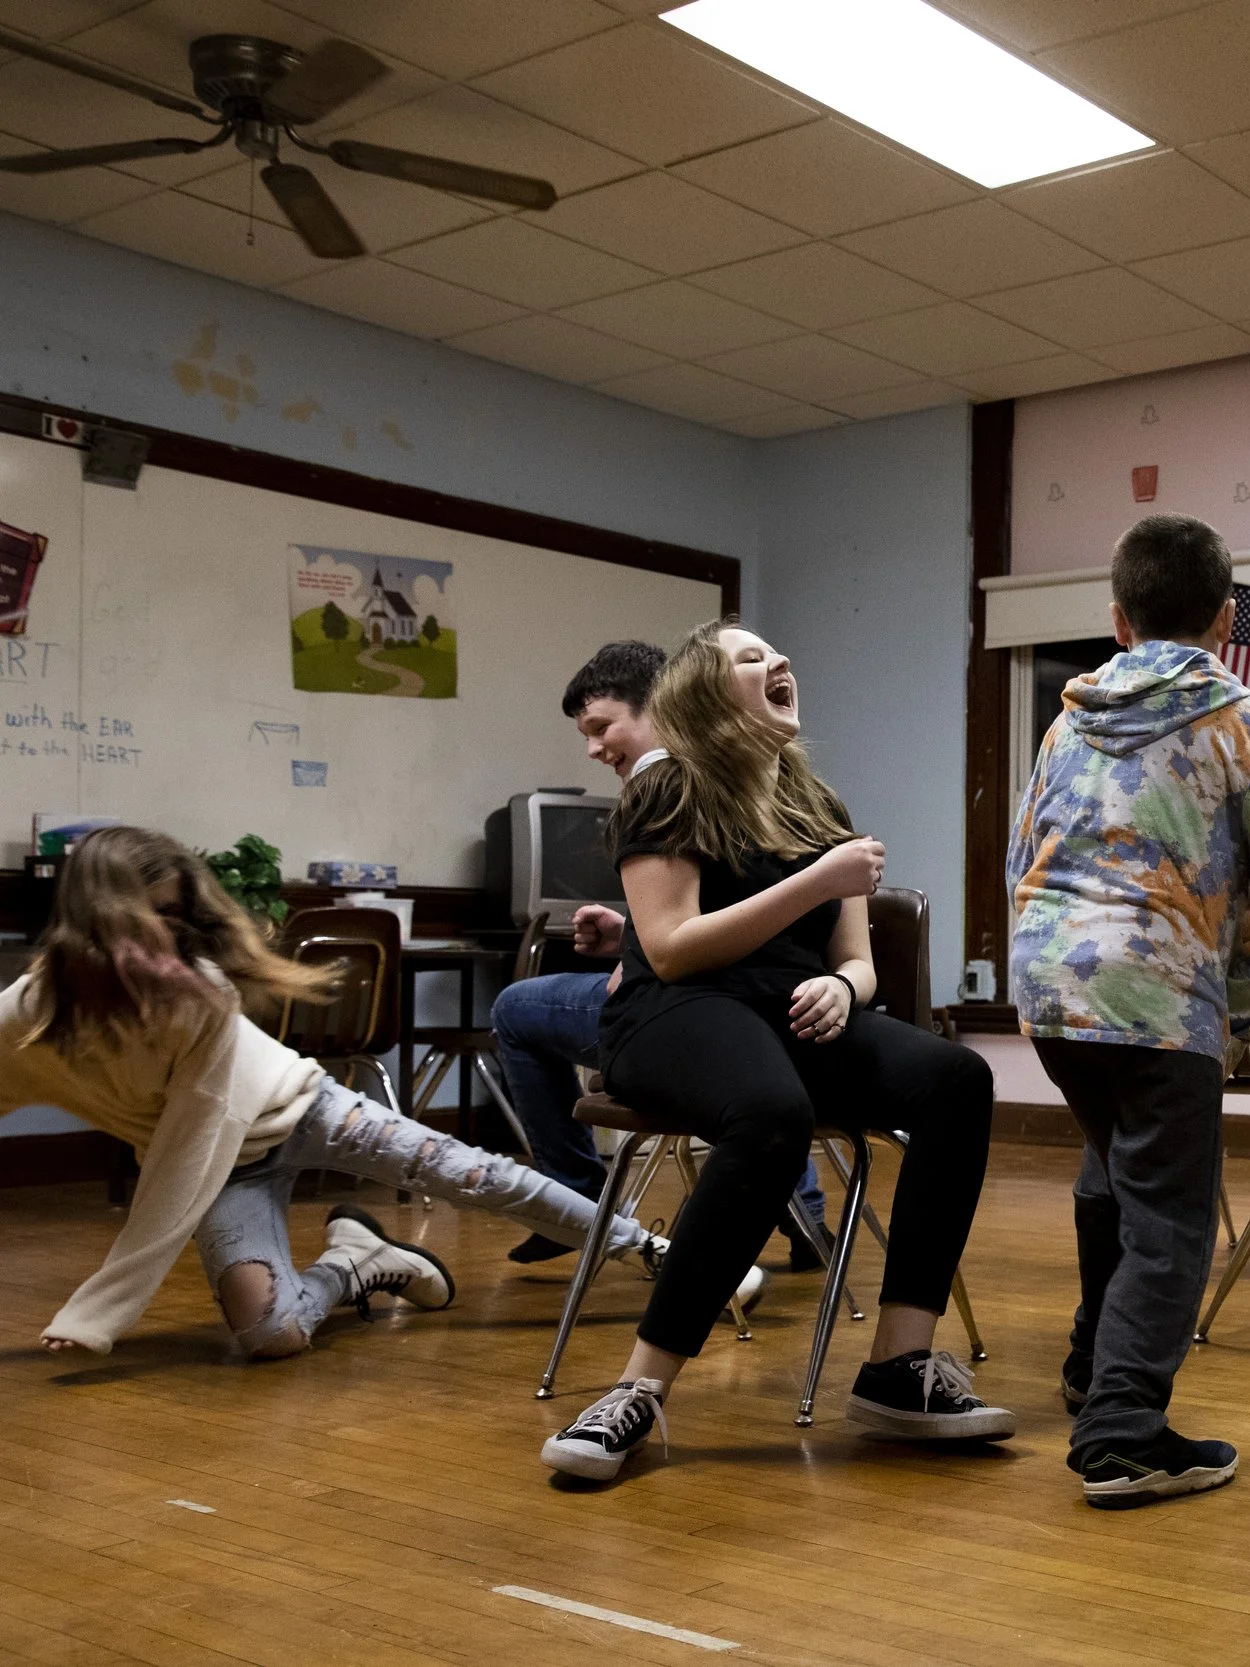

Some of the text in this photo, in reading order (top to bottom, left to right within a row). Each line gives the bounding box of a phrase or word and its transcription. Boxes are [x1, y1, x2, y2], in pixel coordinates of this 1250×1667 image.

[5, 703, 134, 738] with the EAR
[19, 741, 38, 756] to
[81, 743, 142, 769] HEART
